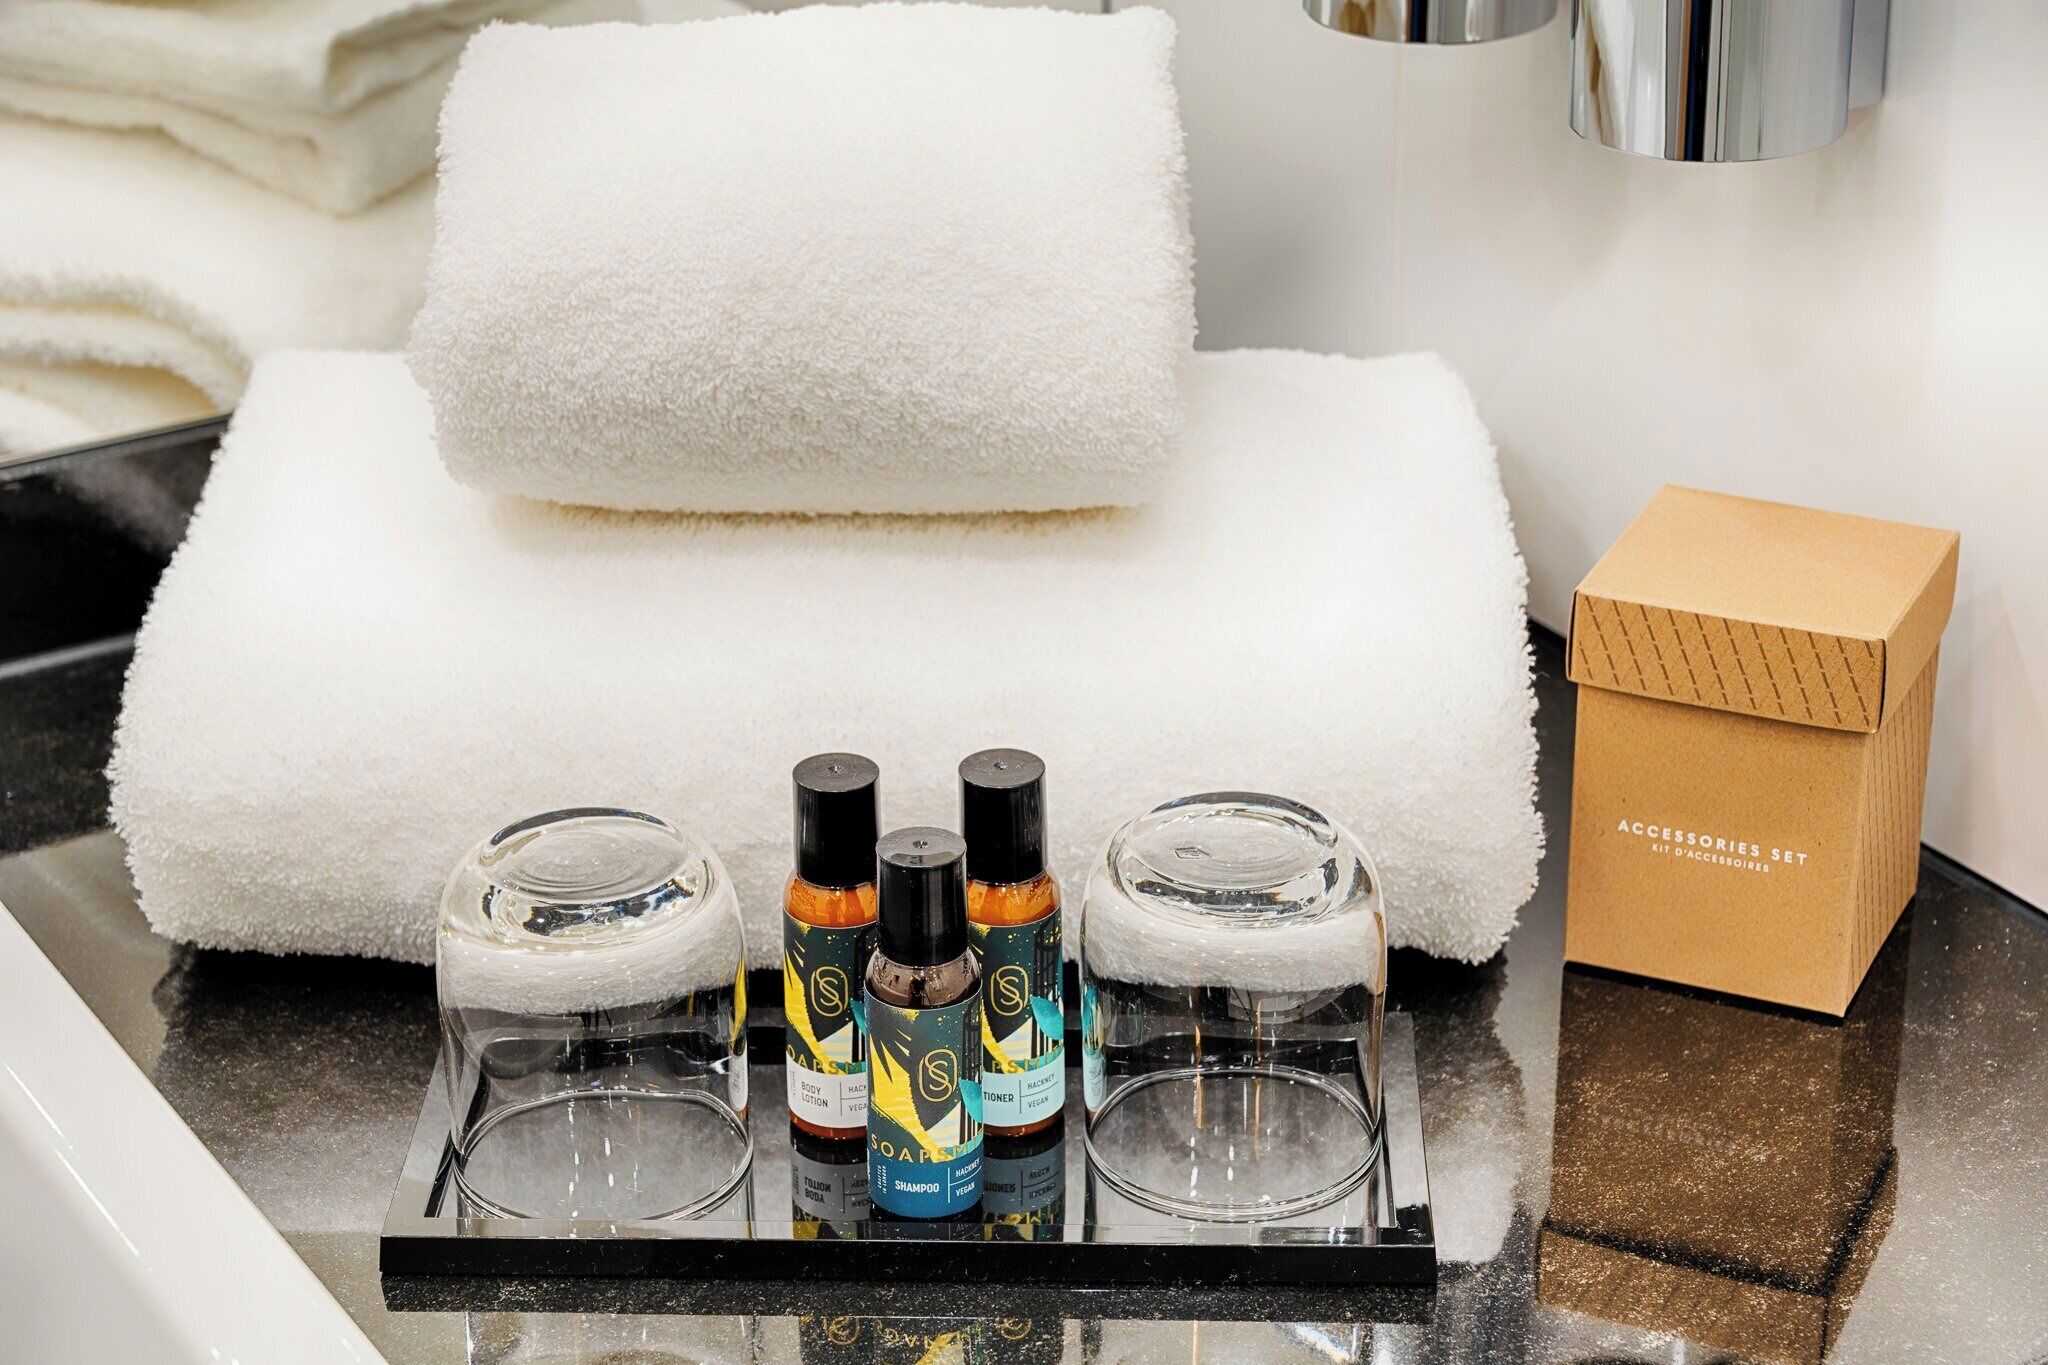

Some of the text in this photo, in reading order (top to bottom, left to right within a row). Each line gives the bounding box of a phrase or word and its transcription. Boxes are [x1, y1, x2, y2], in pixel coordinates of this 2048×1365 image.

[1617, 819, 1808, 866] ACCESSORIES SET
[1652, 843, 1770, 873] KIT D'ACCESSOIRES
[801, 1081, 821, 1095] BODY
[1027, 1073, 1055, 1090] HACKNEY
[801, 1092, 828, 1108] LOTION
[983, 1091, 1014, 1103] TIONER
[1027, 1095, 1049, 1108] VEGAN
[848, 1103, 867, 1112] VEGA
[955, 1157, 980, 1178] HACKNEY
[894, 1180, 940, 1193] SHAMPOO
[955, 1181, 976, 1197] VEGAN
